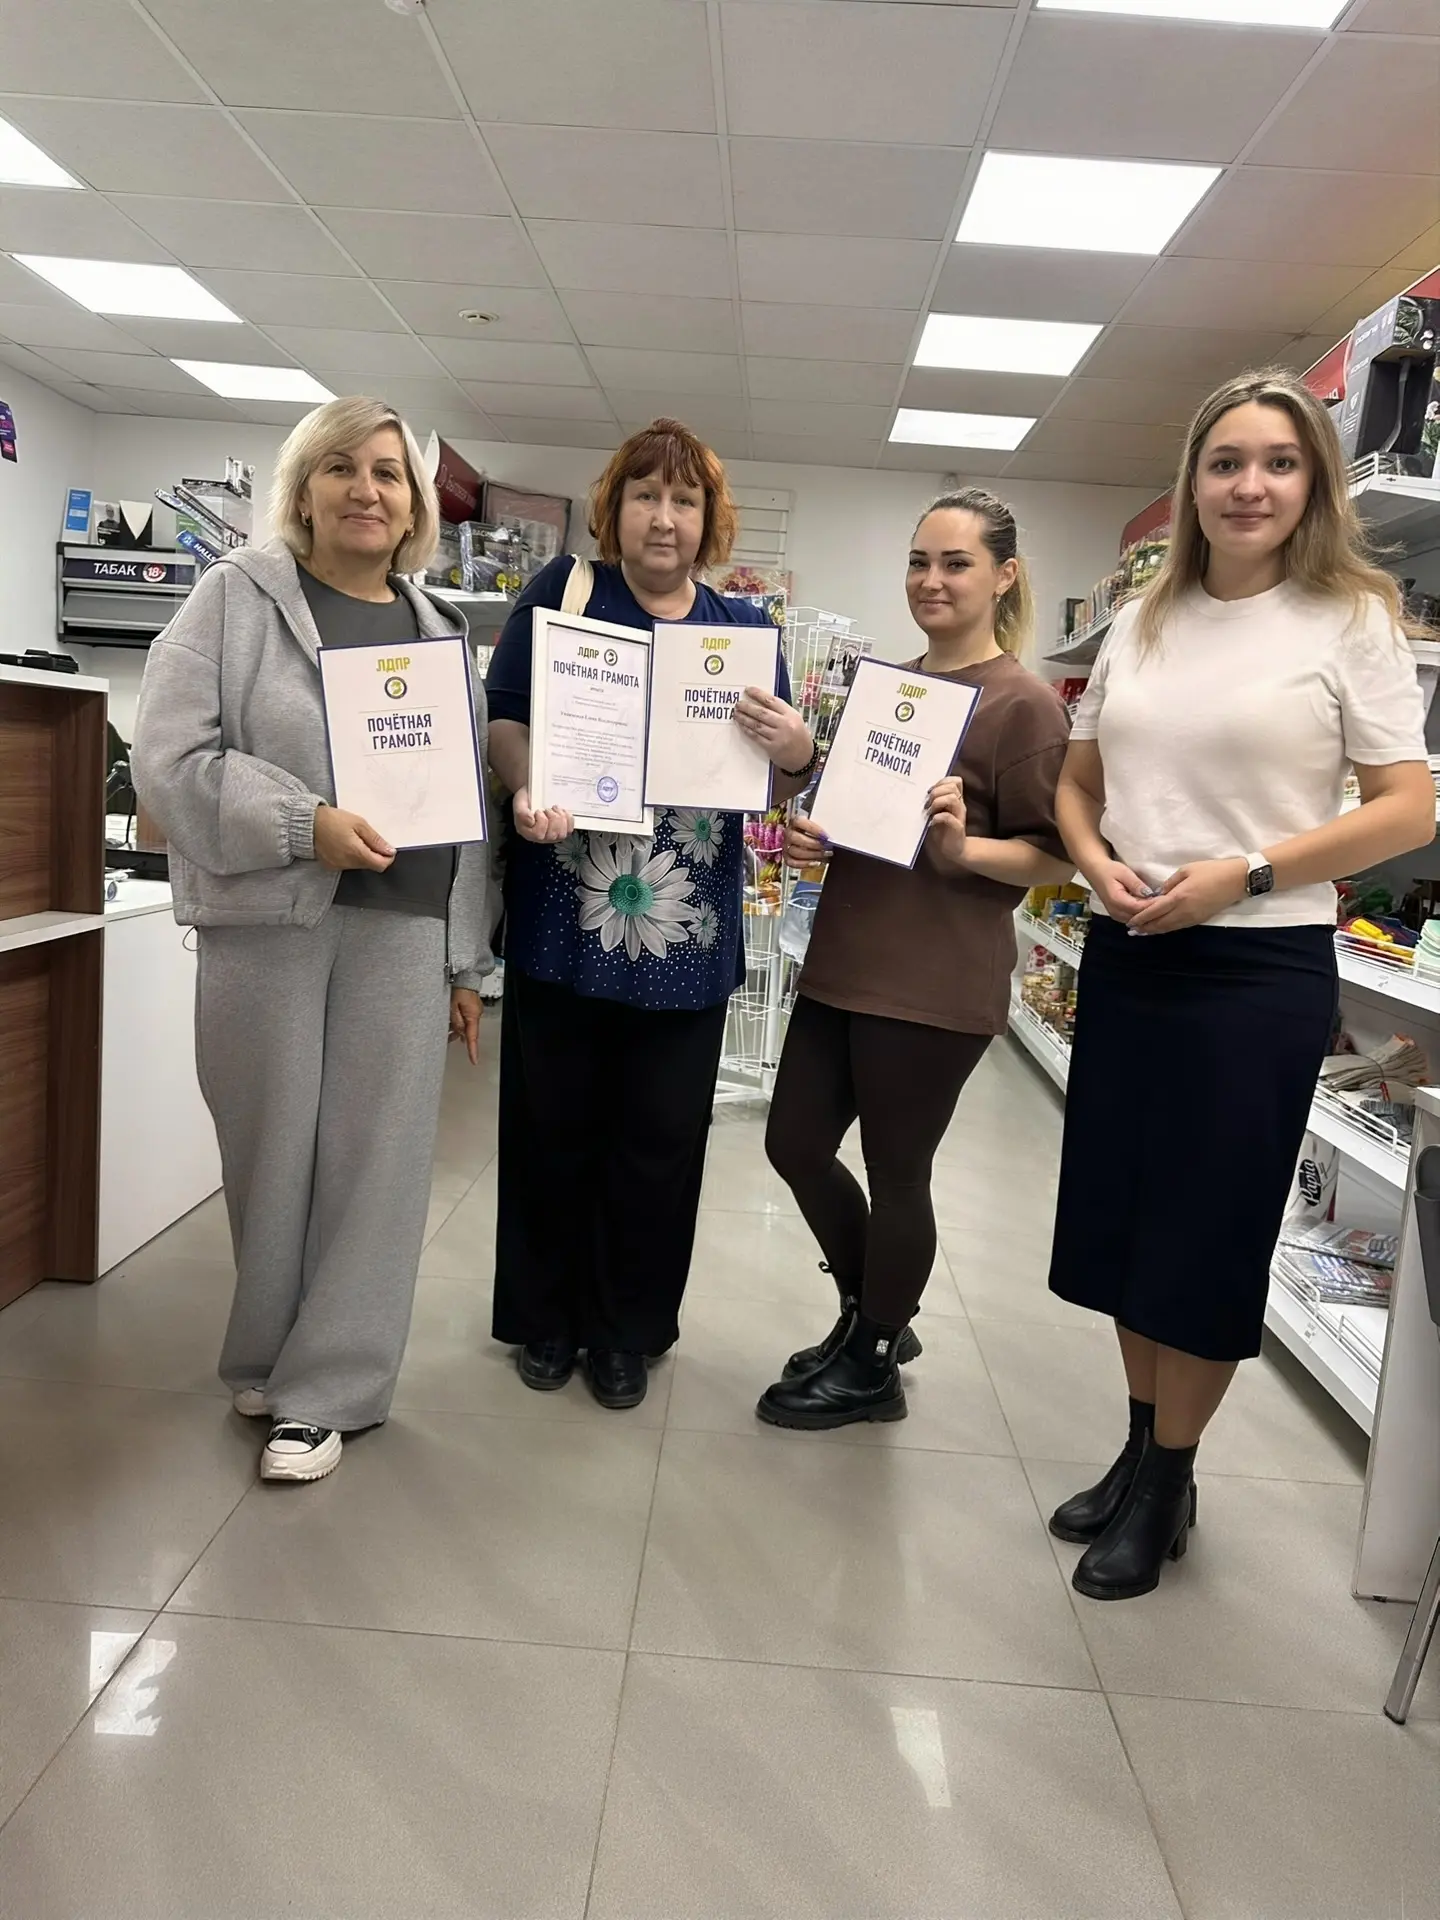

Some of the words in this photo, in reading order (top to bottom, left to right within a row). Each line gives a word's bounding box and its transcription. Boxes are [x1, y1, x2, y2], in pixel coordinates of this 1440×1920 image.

[193, 543, 217, 562] HALLS
[93, 562, 137, 576] ТАБАК
[577, 646, 600, 659] ЛДПР
[700, 637, 731, 650] ЛДПР
[375, 656, 411, 673] ЛДПР
[553, 660, 598, 680] ПОЧЁТНАЯ
[600, 669, 640, 688] ГРАМОТА
[684, 687, 740, 704] ПОЧЁТНАЯ
[896, 682, 928, 700] ЛДПР
[686, 705, 736, 720] ГРАМОТА
[367, 713, 432, 733] ПОЧЁТНАЯ
[372, 731, 432, 750] ГРАМОТА
[866, 729, 921, 759] ПОЧЁТНАЯ
[864, 747, 913, 777] ГРАМОТА
[1299, 1159, 1320, 1206] Papia
